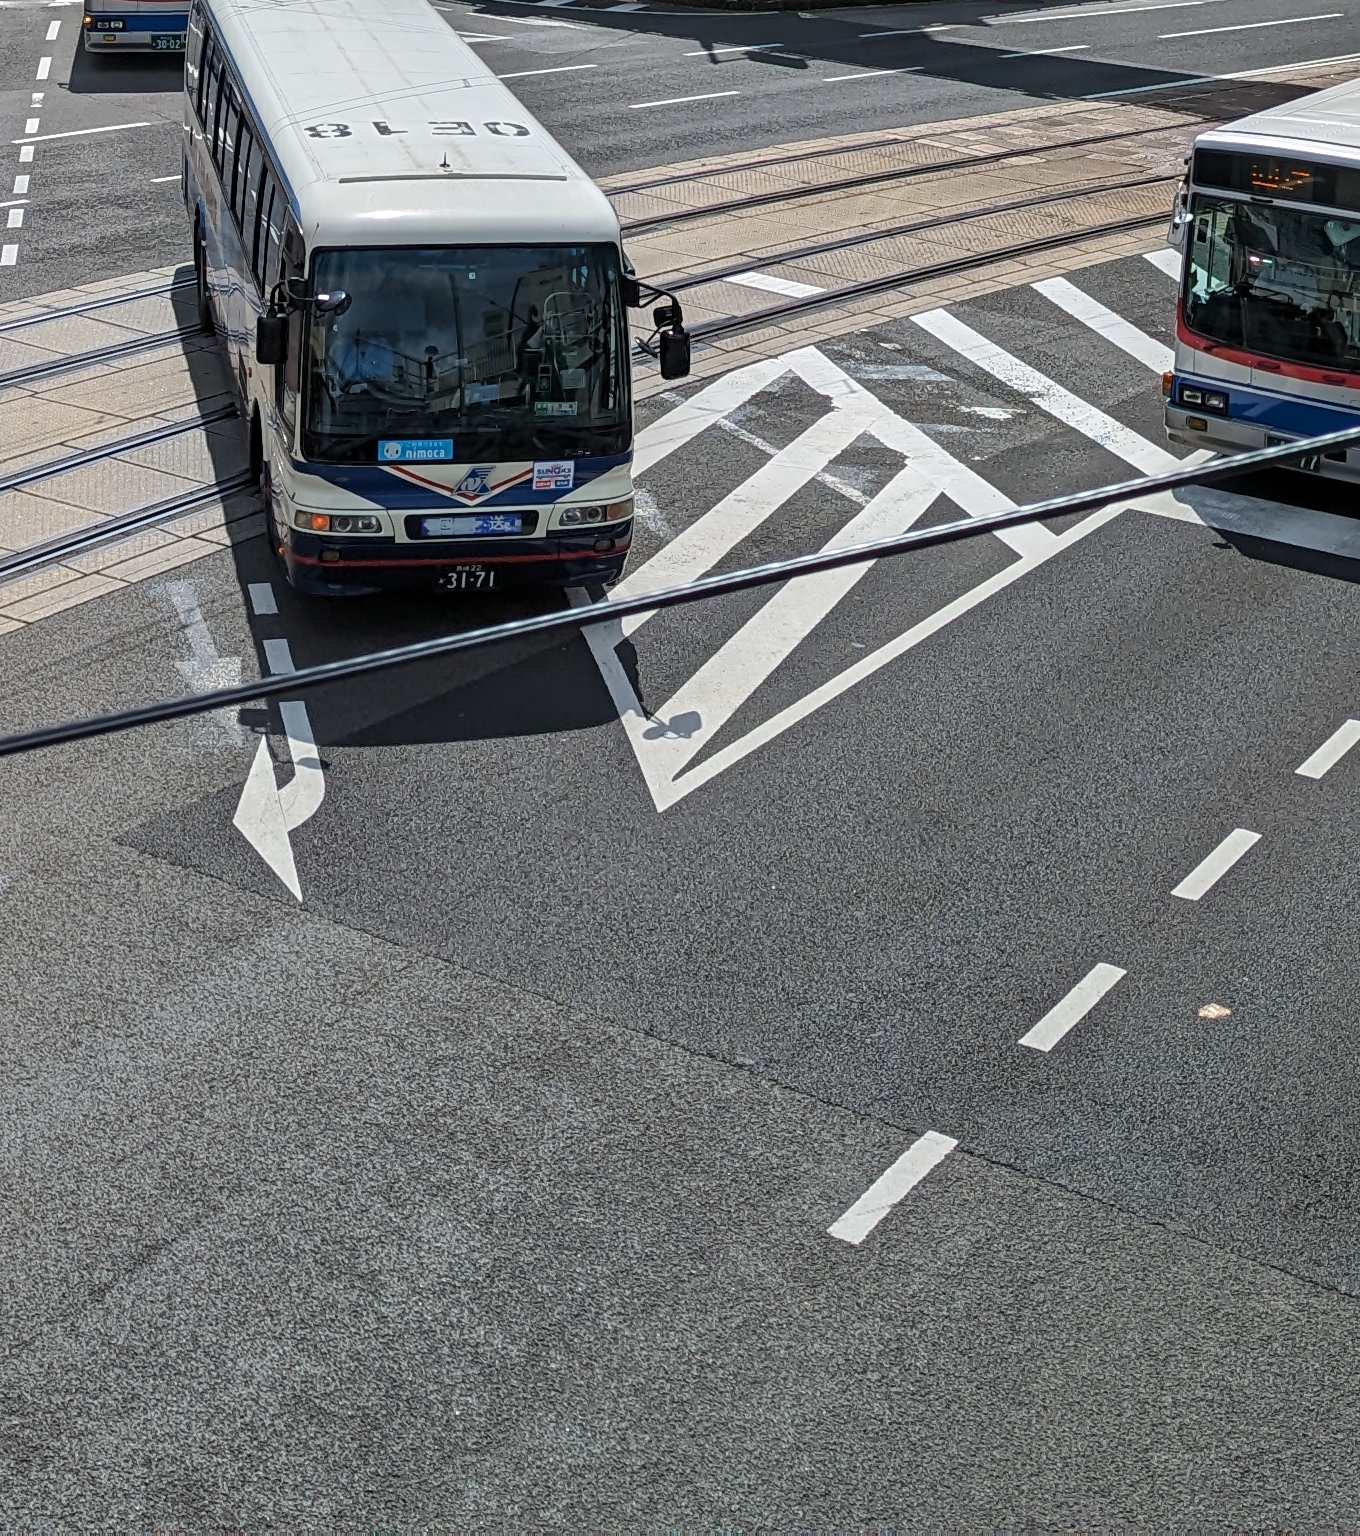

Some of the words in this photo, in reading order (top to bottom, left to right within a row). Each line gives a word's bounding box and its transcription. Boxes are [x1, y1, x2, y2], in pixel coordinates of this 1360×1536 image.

[155, 39, 181, 49] 30-02
[405, 444, 445, 458] nimoca
[446, 571, 495, 589] 31-71
